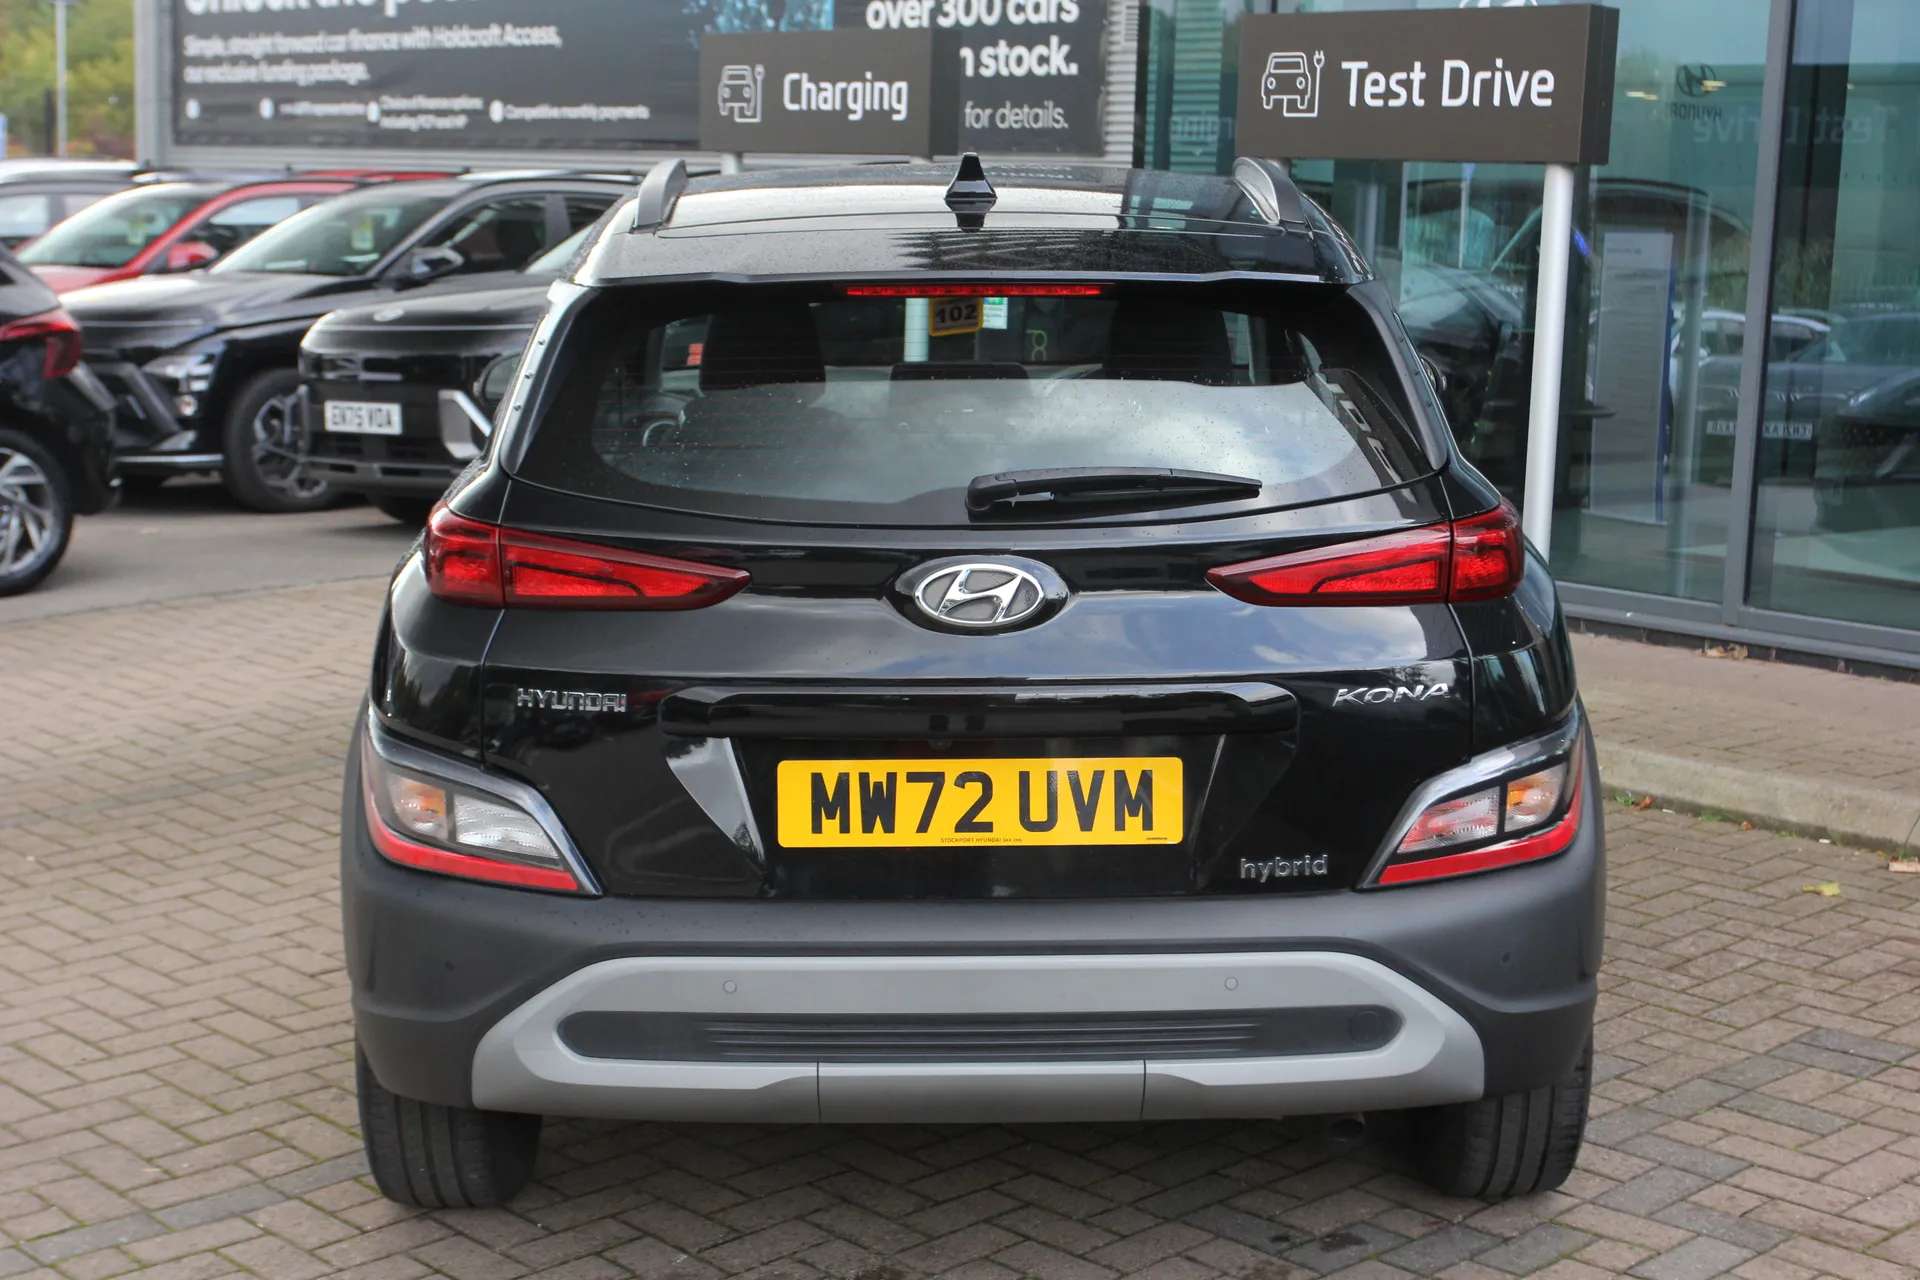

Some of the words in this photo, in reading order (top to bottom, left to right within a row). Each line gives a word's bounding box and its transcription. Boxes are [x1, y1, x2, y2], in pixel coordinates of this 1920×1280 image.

[866, 0, 934, 30] over
[936, 0, 1001, 27] 300
[1006, 0, 1080, 25] cars
[979, 35, 1078, 77] stock.
[783, 71, 908, 121] Charging
[1341, 61, 1426, 107] Test
[1441, 58, 1555, 107] Drive
[965, 101, 992, 128] for
[995, 101, 1069, 129] details.
[936, 304, 978, 322] 102
[517, 688, 627, 712] HYUNDAI
[1332, 683, 1450, 707] KONA
[811, 771, 994, 834] MW72
[1019, 769, 1153, 833] UVM
[1241, 854, 1328, 883] hybrid
